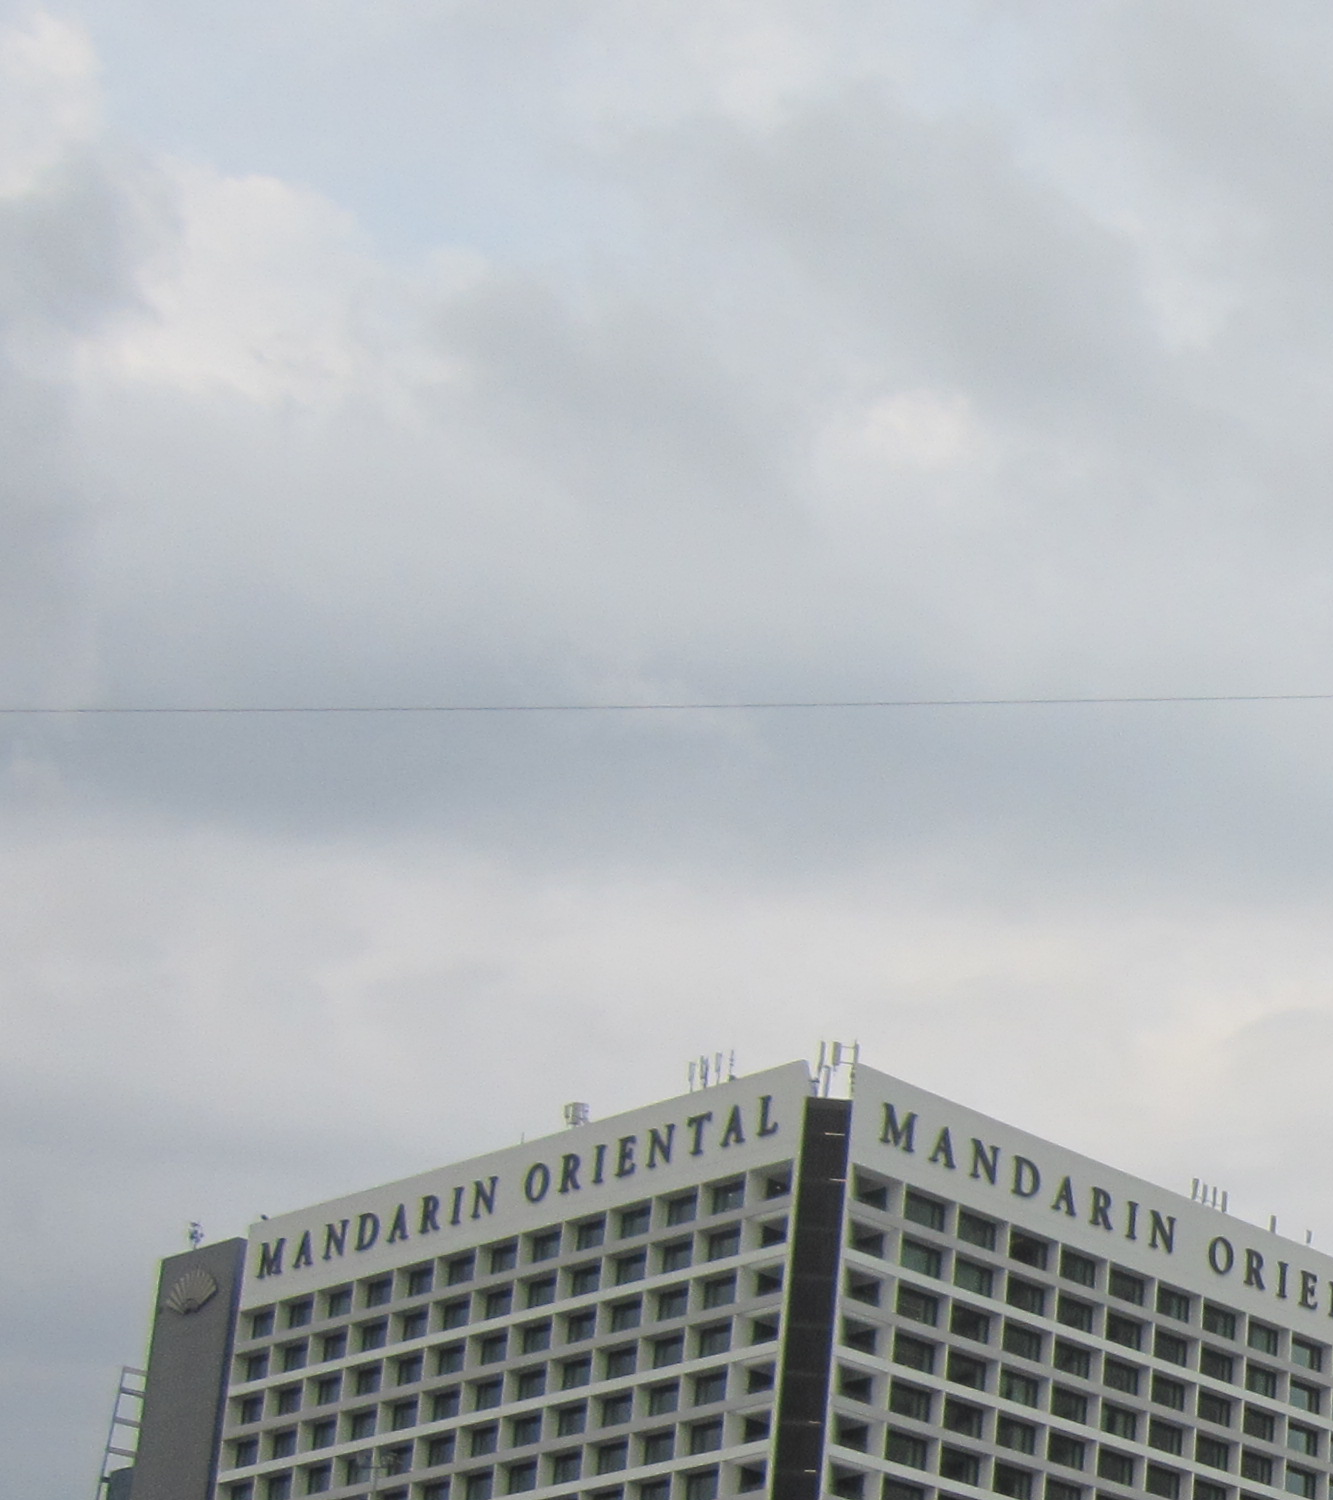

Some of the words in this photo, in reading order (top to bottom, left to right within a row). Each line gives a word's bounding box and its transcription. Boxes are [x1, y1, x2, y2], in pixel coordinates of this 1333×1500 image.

[256, 1175, 499, 1279] MANDARIN
[524, 1094, 780, 1203] ORIENTAL
[880, 1102, 1177, 1255] MANDARIN
